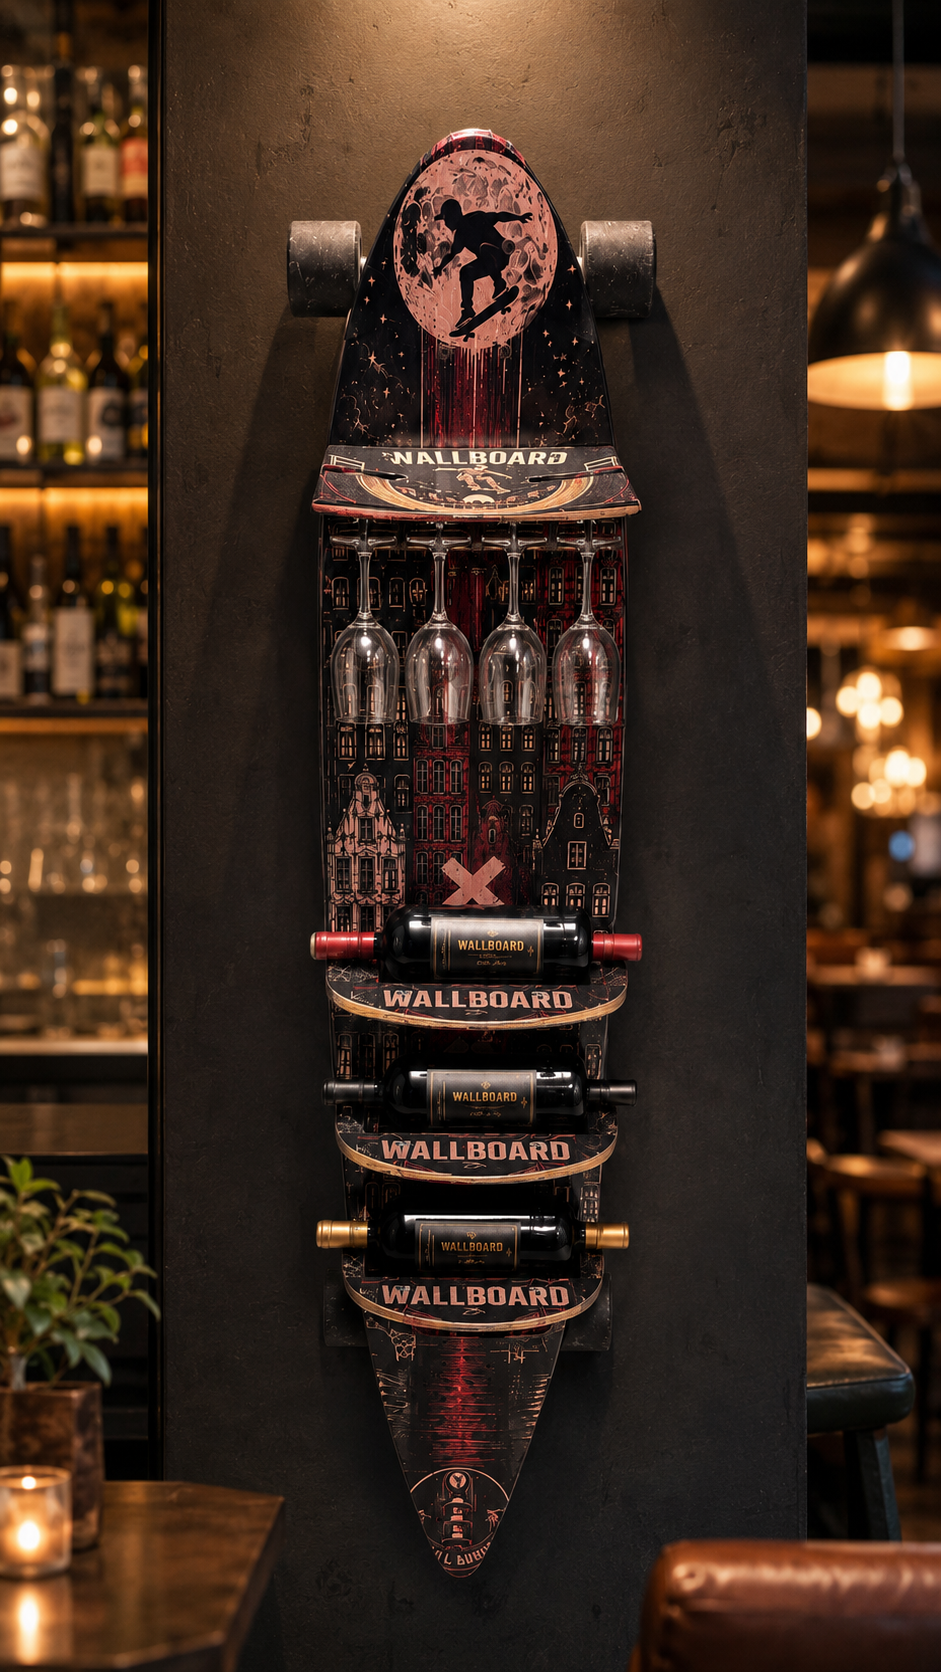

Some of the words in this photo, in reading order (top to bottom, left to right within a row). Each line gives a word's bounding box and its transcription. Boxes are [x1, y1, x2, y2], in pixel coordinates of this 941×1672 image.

[457, 939, 524, 952] WALLBOARD
[383, 989, 573, 1009] WALLBOARD
[452, 1091, 517, 1102] WALLBOARD
[381, 1140, 570, 1161] WALLBOARD
[441, 1241, 503, 1252] WALLBOARD
[381, 1285, 570, 1306] WALLBOARD
